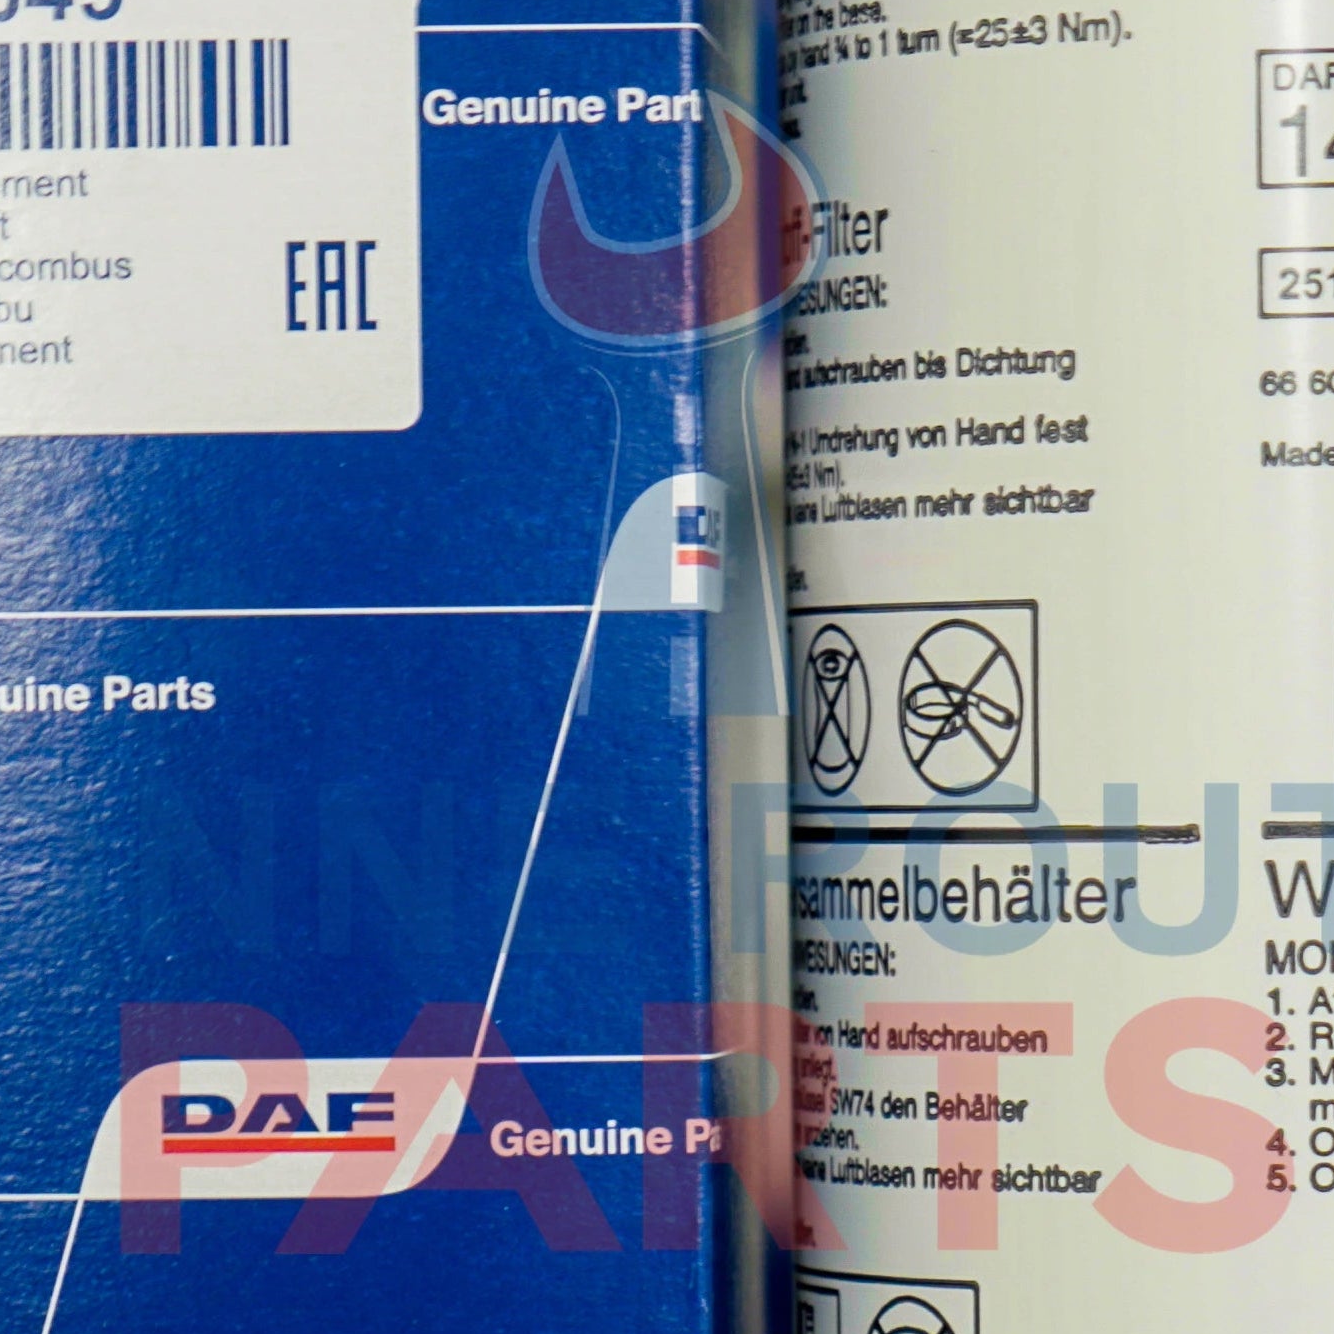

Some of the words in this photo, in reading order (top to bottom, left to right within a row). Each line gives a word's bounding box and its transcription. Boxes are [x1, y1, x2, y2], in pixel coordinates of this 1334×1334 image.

[879, 29, 888, 57] 1
[422, 88, 606, 124] Genuine
[914, 349, 947, 379] bis
[956, 346, 1078, 382] Dichtung
[1260, 370, 1298, 396] 66
[907, 424, 947, 449] von
[956, 414, 1025, 447] Hand
[1035, 413, 1089, 444] fest
[915, 487, 975, 518] mehr
[983, 484, 1096, 517] sichtbar
[102, 675, 216, 712] Parts
[1267, 988, 1295, 1016] 1.
[838, 1020, 880, 1050] Hand
[887, 1021, 1048, 1053] aufschrauben
[1265, 1023, 1295, 1052] 2.
[1265, 1059, 1295, 1088] 3.
[161, 1092, 395, 1134] DAF
[880, 1090, 917, 1120] den
[925, 1091, 1029, 1123] Behälter
[489, 1118, 673, 1157] Genuine
[1265, 1130, 1296, 1157] 4.
[923, 1162, 983, 1193] mehr
[991, 1162, 1103, 1194] sichtbar
[1267, 1164, 1296, 1192] 5.
